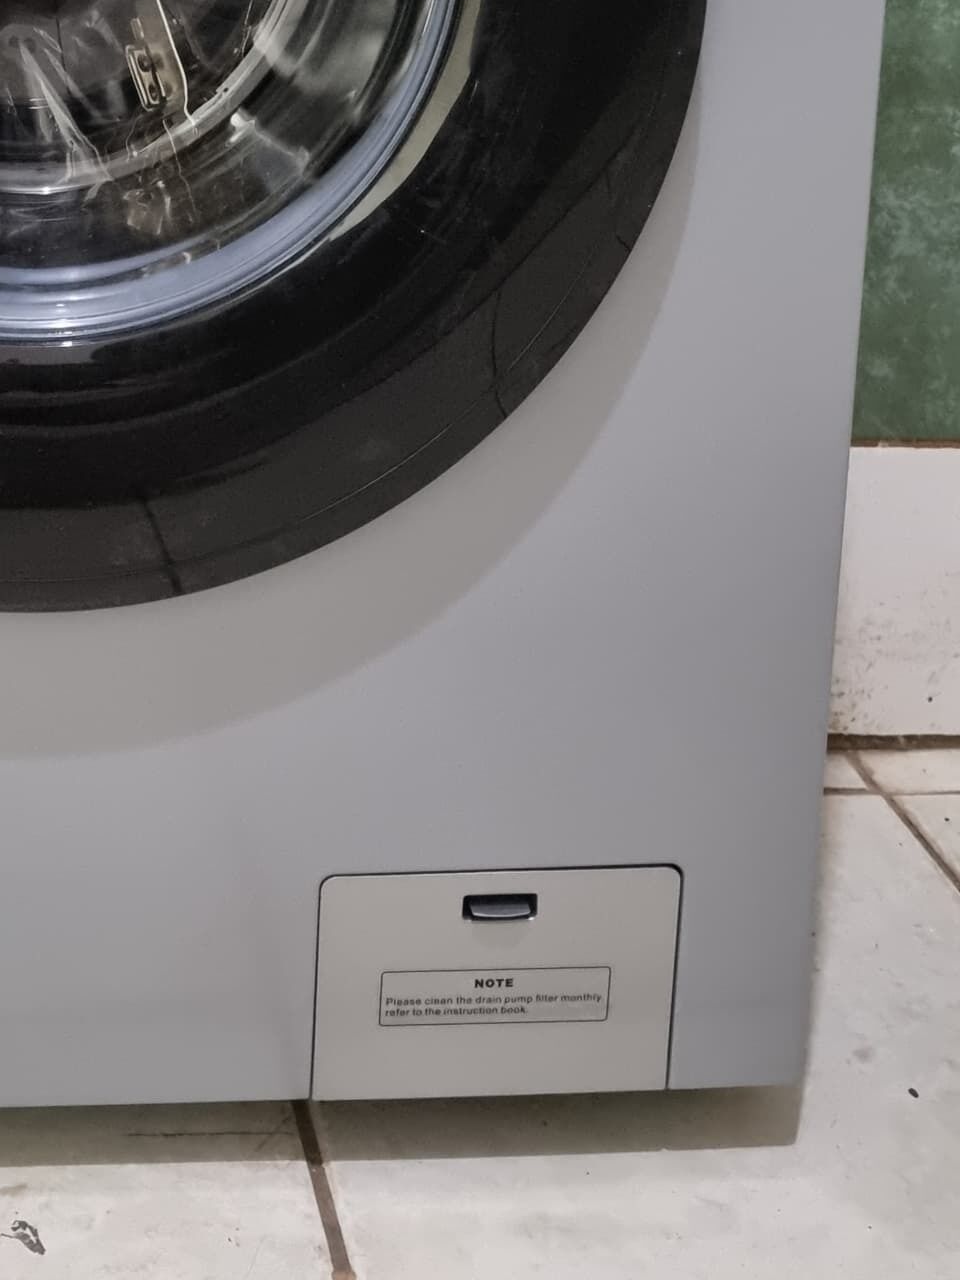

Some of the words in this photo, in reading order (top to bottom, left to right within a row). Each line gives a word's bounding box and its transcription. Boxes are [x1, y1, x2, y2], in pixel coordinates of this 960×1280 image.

[474, 978, 514, 989] NOTE
[385, 997, 422, 1006] Please
[424, 997, 453, 1005] clean
[456, 996, 472, 1005] the
[475, 996, 502, 1005] drain
[504, 995, 533, 1005] pump
[535, 993, 558, 1003] filter
[560, 993, 601, 1002] monthly
[385, 1008, 409, 1016] refer
[412, 1008, 423, 1016] to
[425, 1007, 441, 1016] the
[443, 1006, 498, 1015] instruction
[500, 1005, 528, 1014] book.
